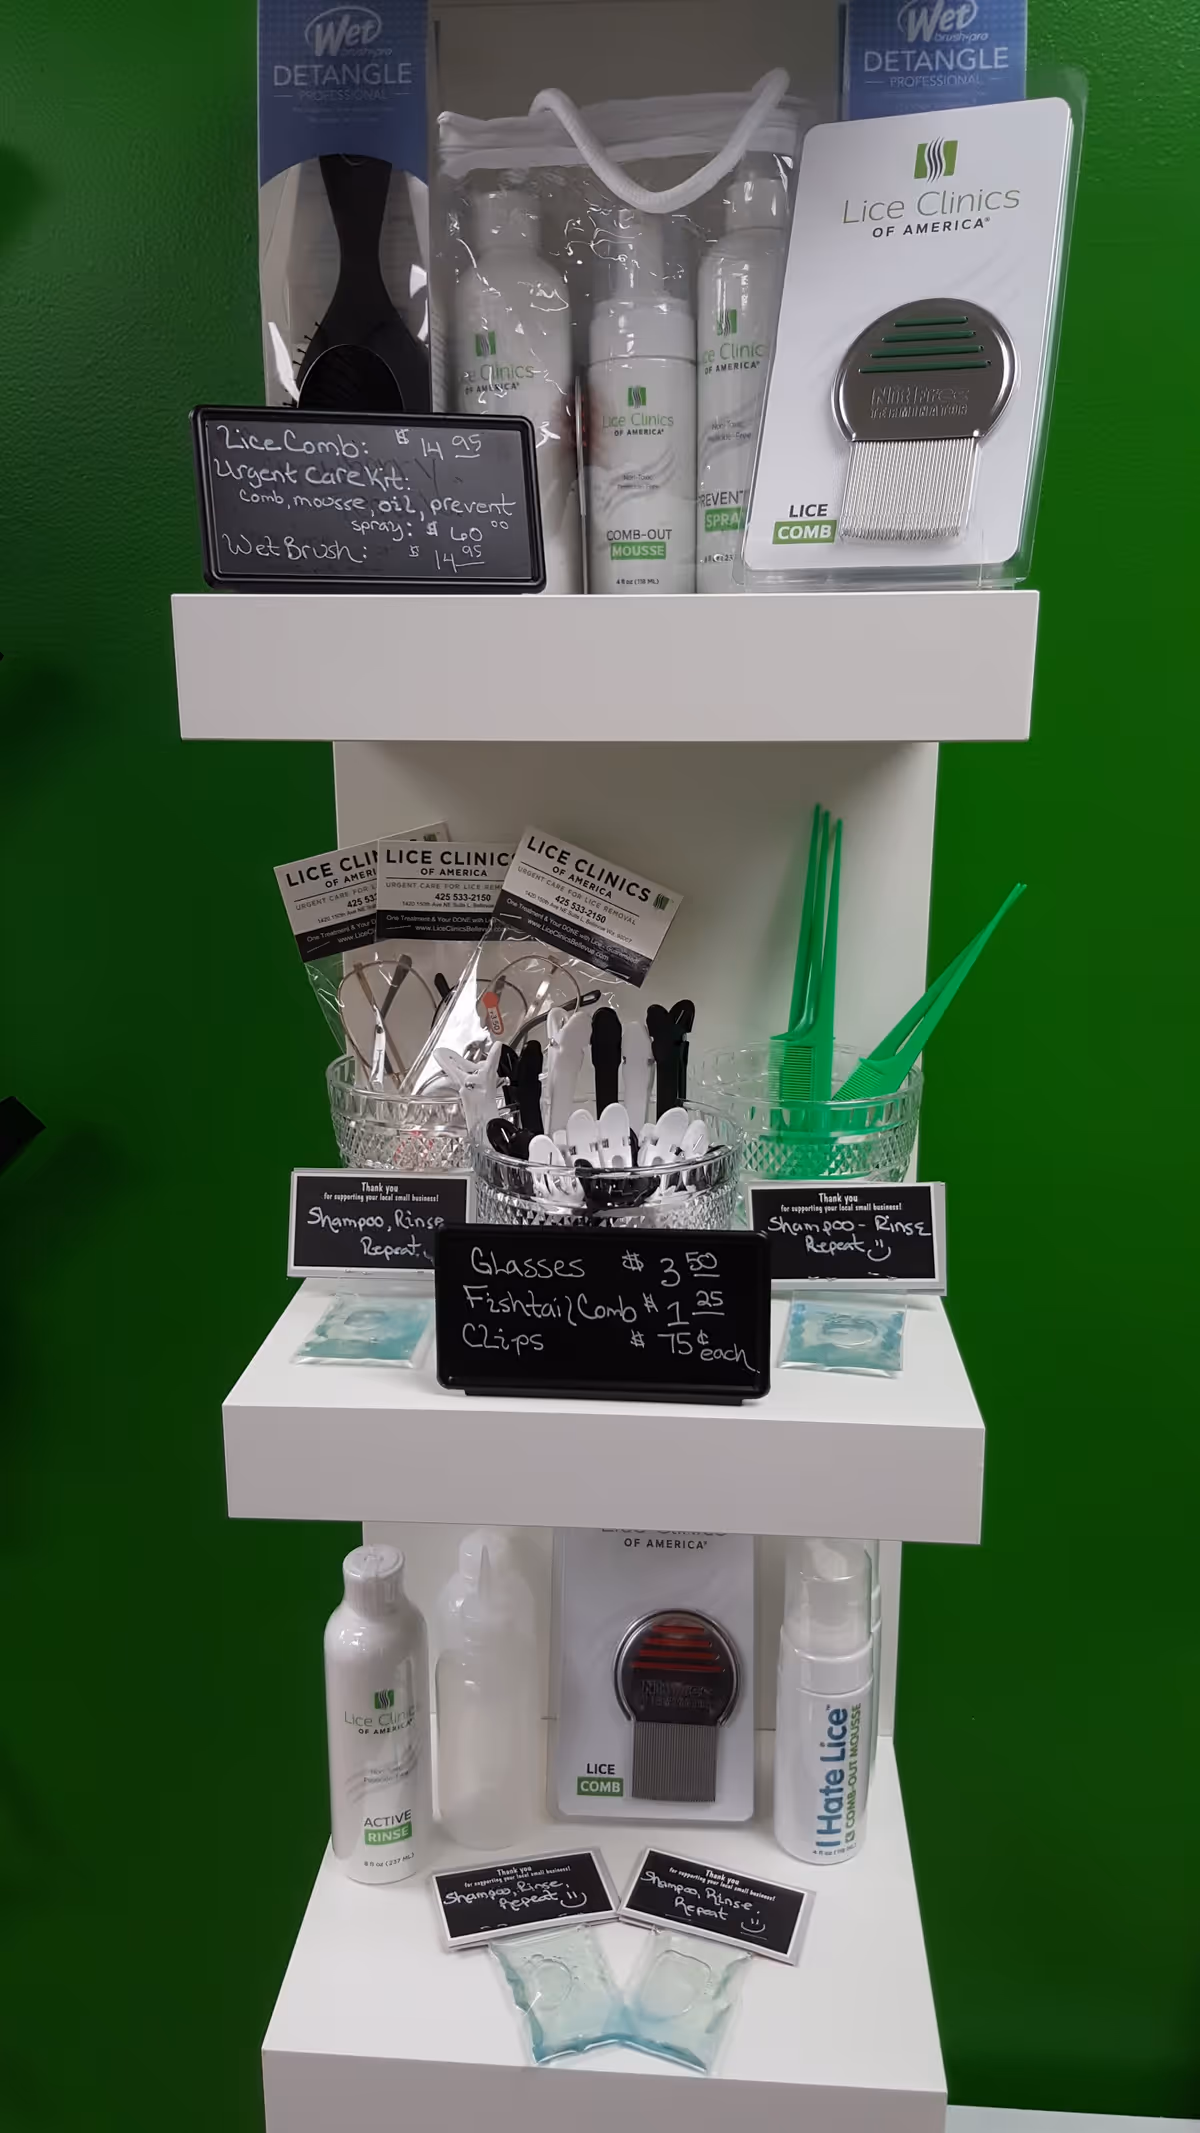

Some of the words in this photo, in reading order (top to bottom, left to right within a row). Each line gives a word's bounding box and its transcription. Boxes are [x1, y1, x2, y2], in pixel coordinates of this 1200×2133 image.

[907, 0, 970, 42] Wet
[315, 14, 376, 56] Wet
[864, 47, 1008, 72] DETANGLE
[274, 63, 412, 86] DETANGLE
[890, 75, 981, 88] PROFESSIONAL
[300, 89, 386, 100] PROFESSIONAL
[843, 199, 904, 224] Lice
[917, 189, 1020, 216] Clinics
[872, 226, 895, 238] OF
[602, 415, 626, 428] Lice
[631, 412, 674, 427] Clinics
[214, 459, 297, 488] Urgent
[305, 467, 366, 488] Care
[431, 493, 516, 516] prevent
[789, 503, 828, 518] LICE
[706, 512, 740, 528] SPRA
[606, 528, 672, 541] COMB-OUT
[777, 524, 832, 540] COMB
[222, 534, 280, 556] Wet
[612, 545, 665, 557] MOUSSE
[386, 849, 432, 864] LICE
[286, 862, 333, 887] LICE
[420, 868, 435, 876] OF
[440, 868, 488, 877] AMERICA
[527, 836, 571, 865] LICE
[574, 858, 652, 902] CLINICS
[325, 879, 339, 888] OF
[552, 866, 566, 876] OF
[568, 874, 612, 899] AMERICA
[296, 897, 326, 911] URGENT
[329, 891, 349, 902] CARE
[353, 885, 368, 895] FOR
[347, 898, 363, 908] 425
[435, 893, 450, 901] 425
[453, 893, 491, 902] 533-2150
[518, 866, 547, 882] URGENT
[546, 879, 566, 892] CARE
[568, 889, 582, 900] FOR
[584, 897, 602, 909] LICE
[603, 906, 636, 925] REMOVAL
[386, 914, 399, 922] One
[506, 898, 518, 907] One
[519, 902, 544, 920] Treatment
[562, 924, 579, 936] DONE
[555, 895, 570, 907] 425
[571, 901, 606, 924] 533-2150
[307, 934, 320, 942] One
[361, 1182, 383, 1192] Thank
[386, 1185, 398, 1194] you
[323, 1192, 332, 1200] for
[334, 1193, 364, 1202] supporting
[365, 1194, 377, 1202] your
[379, 1193, 393, 1201] local
[412, 1194, 439, 1202] business!
[818, 1193, 842, 1203] Thank
[844, 1194, 858, 1205] you
[781, 1204, 789, 1212] for
[791, 1205, 823, 1214] supporting
[824, 1205, 837, 1213] your
[855, 1203, 871, 1211] small
[873, 1202, 902, 1211] business!
[471, 1247, 585, 1278] Glasses
[577, 1293, 637, 1323] Comb
[462, 1323, 544, 1356] Clips
[624, 1538, 640, 1547] OF
[345, 1711, 373, 1727] Lice
[850, 1703, 861, 1757] MOUSSE
[586, 1763, 615, 1775] LICE
[580, 1781, 620, 1793] COMB
[845, 1761, 859, 1826] COMB-OUT
[816, 1768, 845, 1835] Hate
[364, 1809, 411, 1827] ACTIVE
[368, 1825, 409, 1842] RINSE
[474, 1877, 503, 1887] supporting
[504, 1875, 515, 1883] your
[516, 1872, 529, 1880] local
[531, 1869, 545, 1877] small
[546, 1865, 571, 1875] business!
[497, 1867, 518, 1877] Thank
[519, 1866, 532, 1874] you
[705, 1869, 726, 1882] Thank
[727, 1875, 740, 1886] you
[678, 1870, 706, 1883] supporting
[706, 1877, 719, 1886] your
[720, 1880, 734, 1890] local
[734, 1884, 749, 1895] small
[750, 1889, 776, 1902] business!
